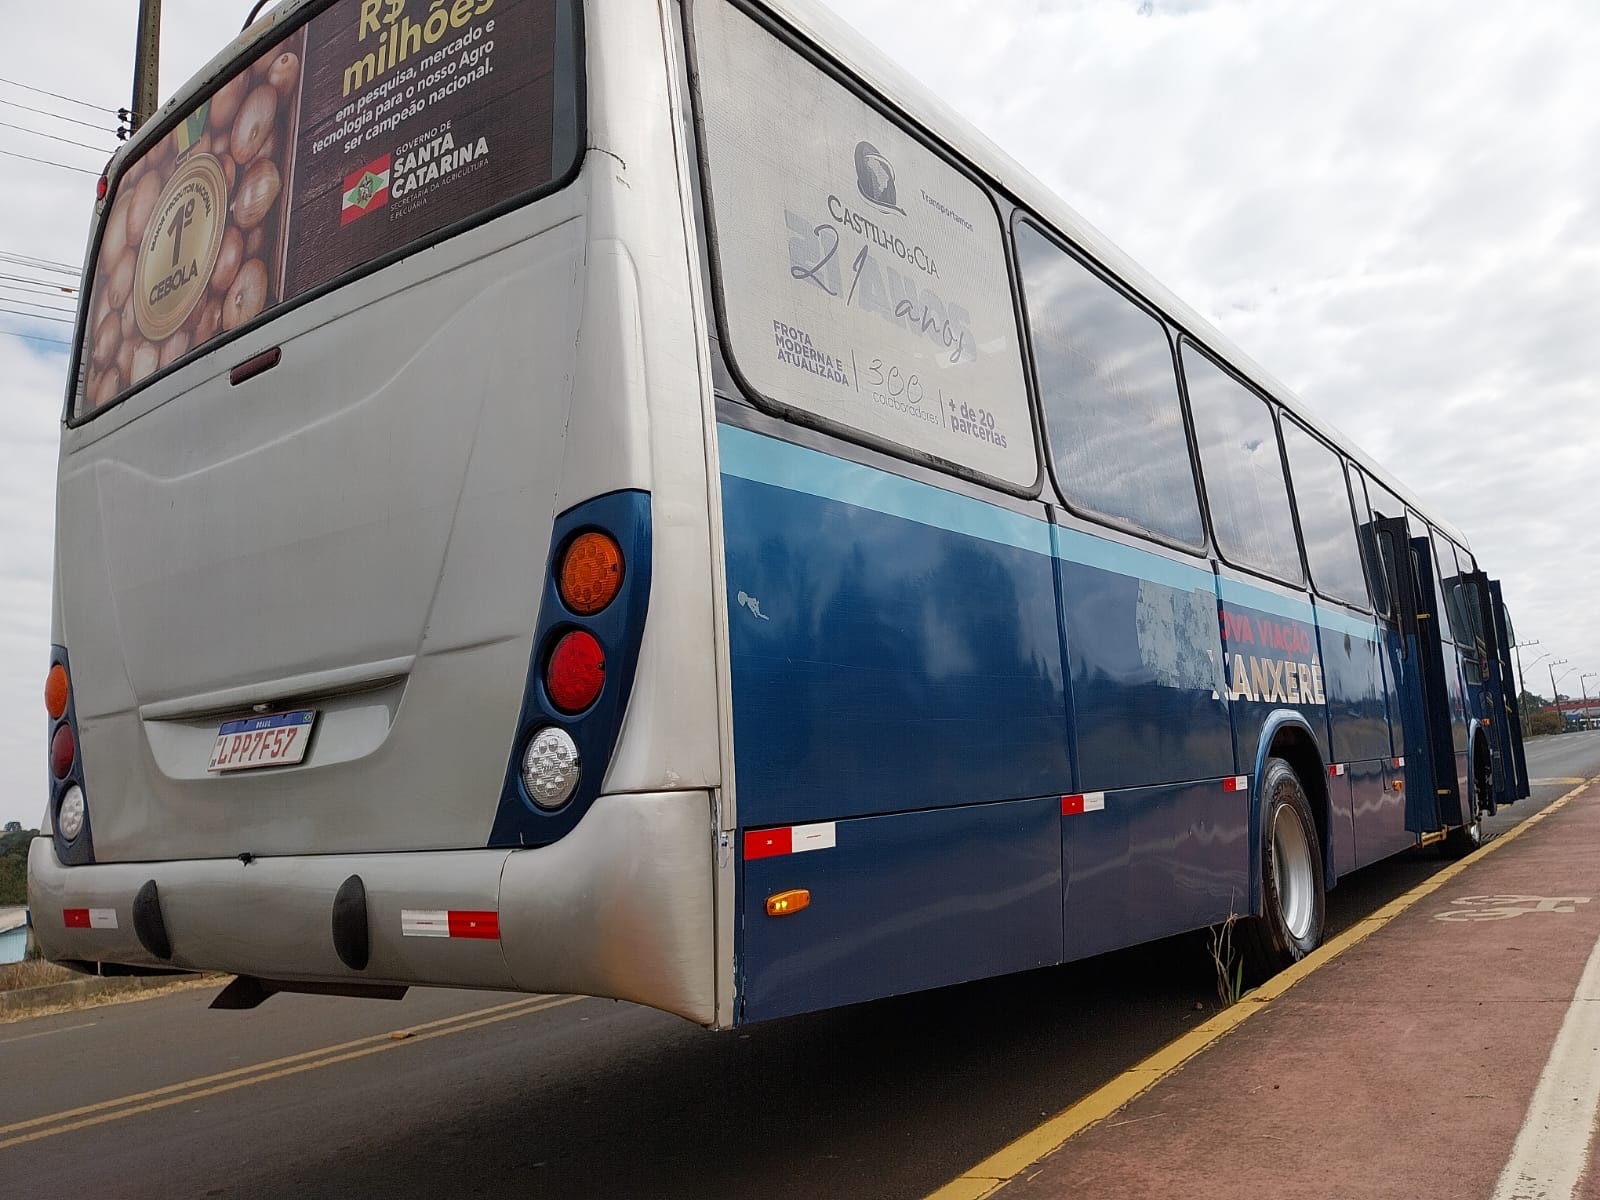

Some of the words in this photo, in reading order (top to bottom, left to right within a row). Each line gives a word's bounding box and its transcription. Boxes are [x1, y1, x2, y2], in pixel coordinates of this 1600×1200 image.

[335, 104, 355, 123] em
[357, 67, 417, 115] pesquisa,
[420, 26, 482, 71] mercado
[485, 19, 496, 33] e
[312, 110, 373, 154] tecnologia
[375, 92, 402, 120] para
[406, 85, 414, 99] o
[417, 63, 456, 93] nosso
[459, 40, 494, 69] Agro
[344, 135, 364, 154] ser
[365, 99, 425, 140] campeão
[429, 58, 494, 106] nacional.
[393, 132, 455, 178] SANTA
[395, 128, 438, 156] GOVERNO
[439, 120, 452, 133] DE
[391, 136, 489, 199] CATARINA
[442, 158, 489, 185] AGRICULTURA
[149, 258, 198, 306] CEBOLA
[773, 319, 813, 347] FROTA
[775, 333, 834, 369] MODERNA
[836, 358, 844, 372] E
[777, 348, 850, 387] ATUALIZADA
[867, 358, 924, 404] 300
[950, 415, 1008, 449] parcerias
[960, 402, 977, 423] de
[978, 408, 996, 431] 20
[1256, 618, 1311, 661] VIAÇÃO
[217, 727, 298, 764] LPP7F57
